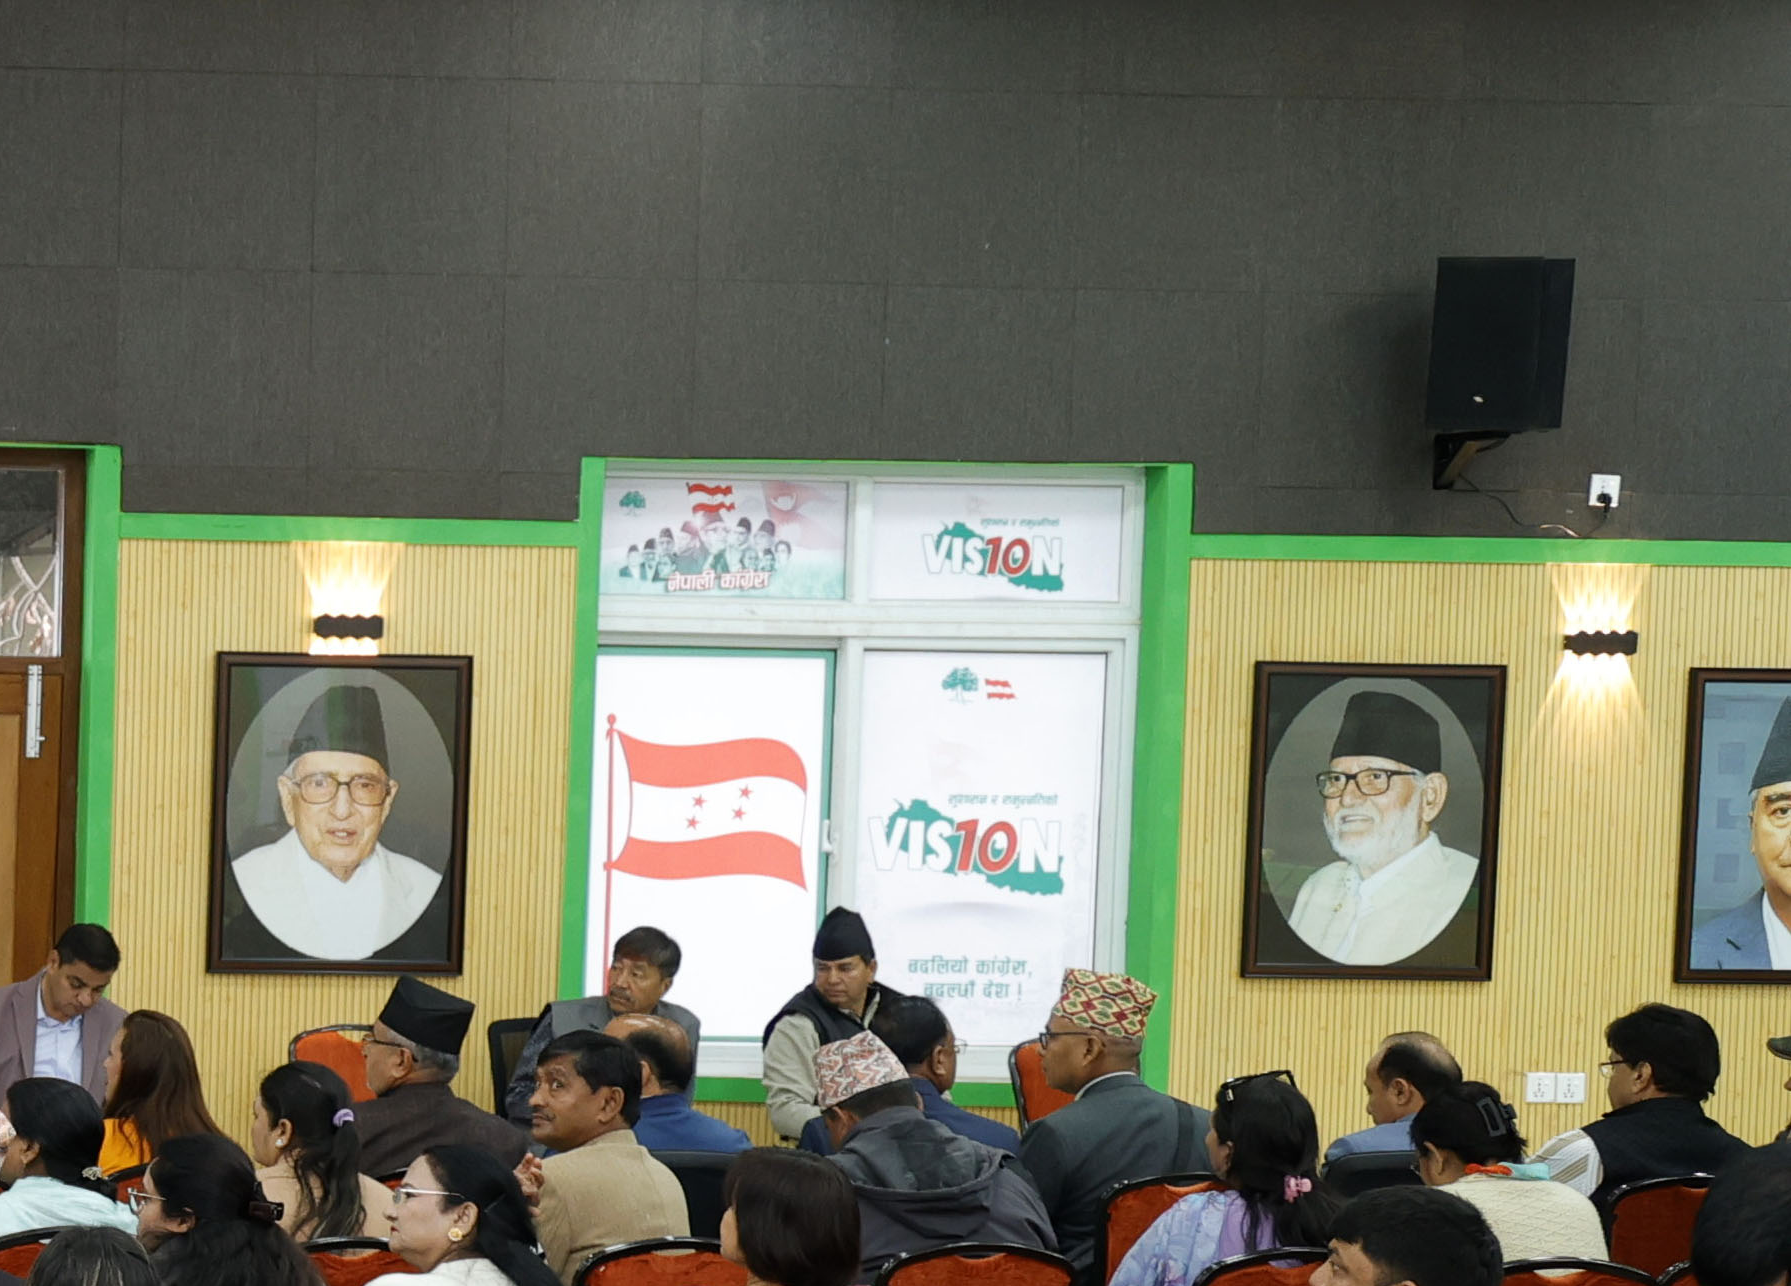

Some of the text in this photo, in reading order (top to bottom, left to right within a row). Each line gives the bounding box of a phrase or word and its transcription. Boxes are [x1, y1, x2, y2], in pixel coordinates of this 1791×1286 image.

[667, 569, 716, 592] नेपाली
[908, 954, 968, 974] बदलियो
[983, 979, 1010, 998] देश
